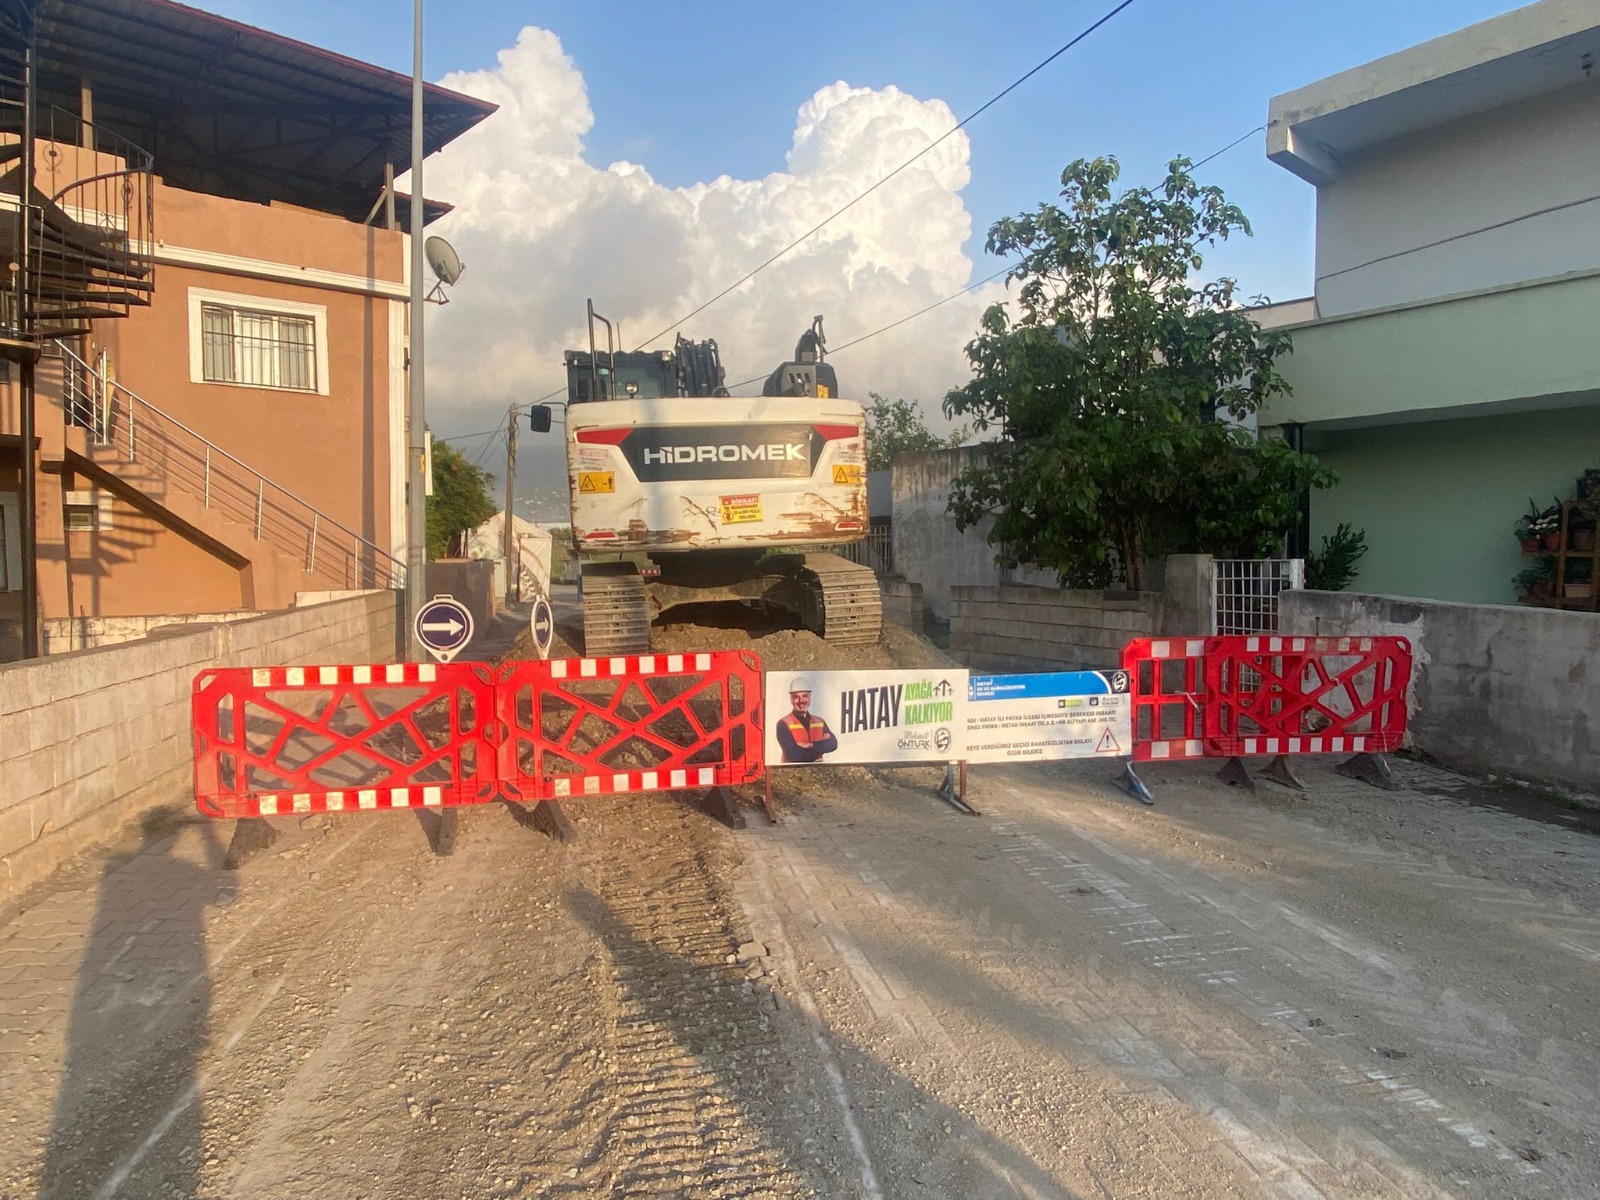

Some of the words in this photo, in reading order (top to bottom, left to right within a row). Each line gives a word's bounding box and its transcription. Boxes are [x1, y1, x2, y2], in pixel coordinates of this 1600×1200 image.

[904, 679, 933, 701] AYAĞA
[841, 684, 903, 734] HATAY
[905, 702, 952, 725] KALKIYOR
